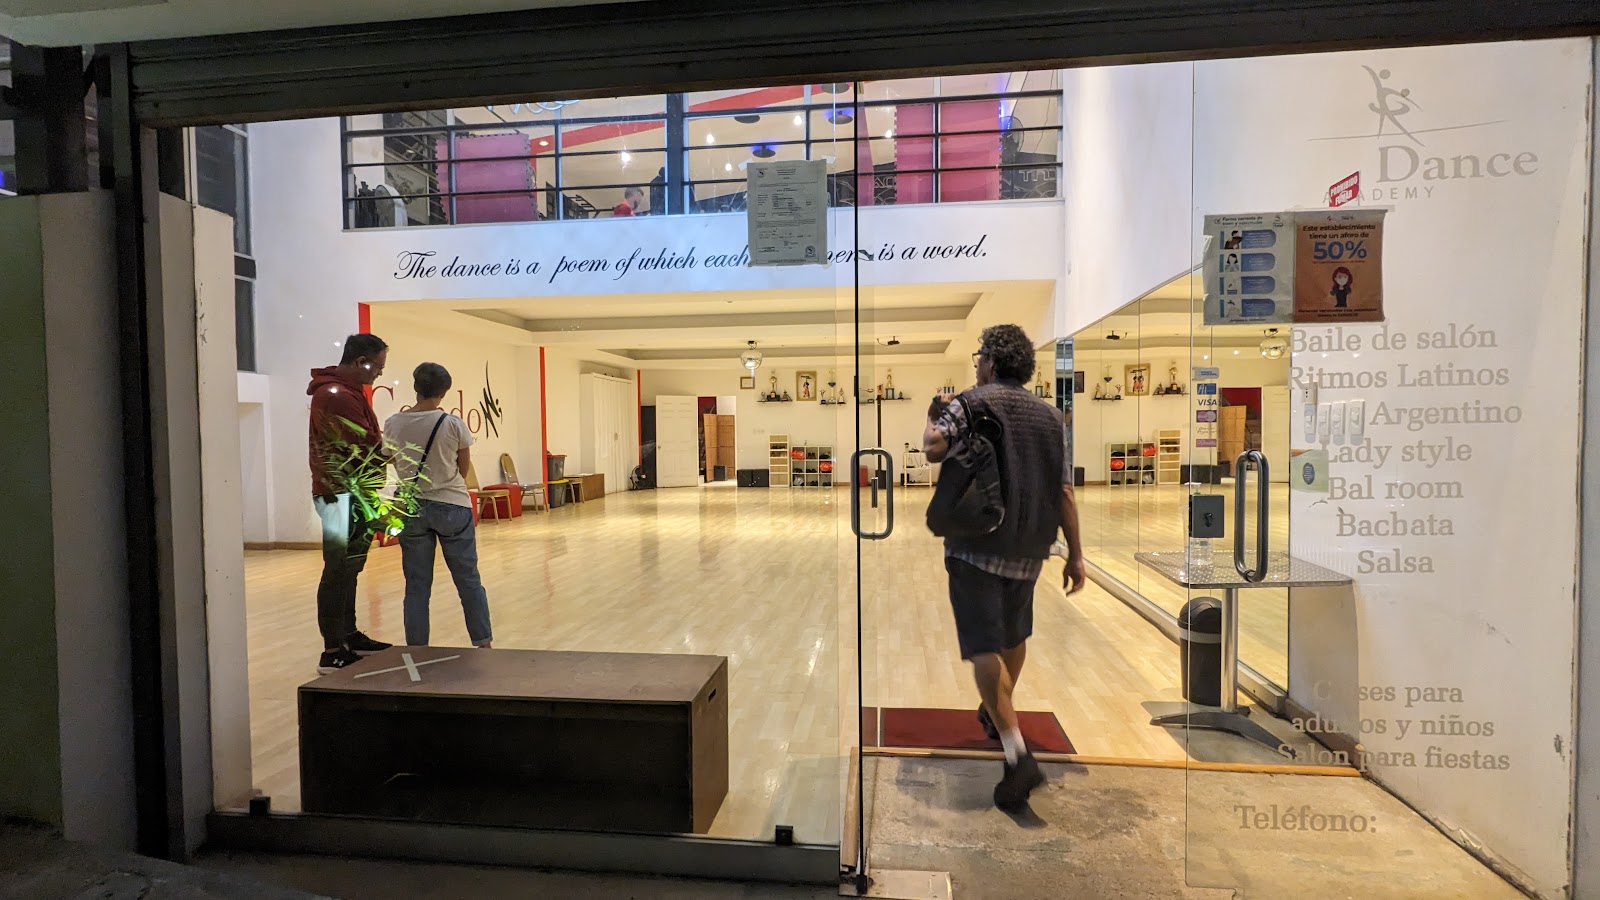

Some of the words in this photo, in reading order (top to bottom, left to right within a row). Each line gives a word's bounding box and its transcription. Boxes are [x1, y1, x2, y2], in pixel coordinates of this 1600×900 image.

[1376, 145, 1538, 183] Dance
[1322, 185, 1434, 204] AADEMY
[1320, 223, 1376, 231] establecimiento
[394, 250, 437, 280] The
[440, 256, 501, 278] dance
[505, 257, 521, 277] is
[525, 261, 542, 276] a
[547, 255, 611, 284] poem
[612, 247, 643, 281] of
[638, 246, 699, 271] which
[703, 244, 750, 269] each
[878, 243, 896, 262] is
[901, 246, 919, 261] a
[922, 234, 988, 259] word.
[1313, 240, 1368, 260] 50%
[1290, 326, 1362, 354] Baile
[1371, 325, 1407, 350] de
[1416, 323, 1498, 350] salón
[1289, 365, 1388, 391] Ritmos
[1397, 362, 1510, 388] Latinos
[1369, 400, 1523, 432] Argentino
[1321, 438, 1393, 469] Lady
[1401, 436, 1473, 469] style
[1327, 475, 1375, 500] Bal
[1385, 480, 1464, 499] room
[1336, 511, 1455, 537] Bachata
[1357, 549, 1435, 574] Salsa
[1313, 680, 1396, 702] Cses
[1405, 686, 1464, 708] para
[1291, 711, 1387, 735] aduos
[1395, 719, 1412, 740] y
[1419, 714, 1495, 737] niños
[1358, 750, 1416, 772] para
[1425, 746, 1511, 770] fiestas
[1233, 804, 1377, 833] Teléfono:
